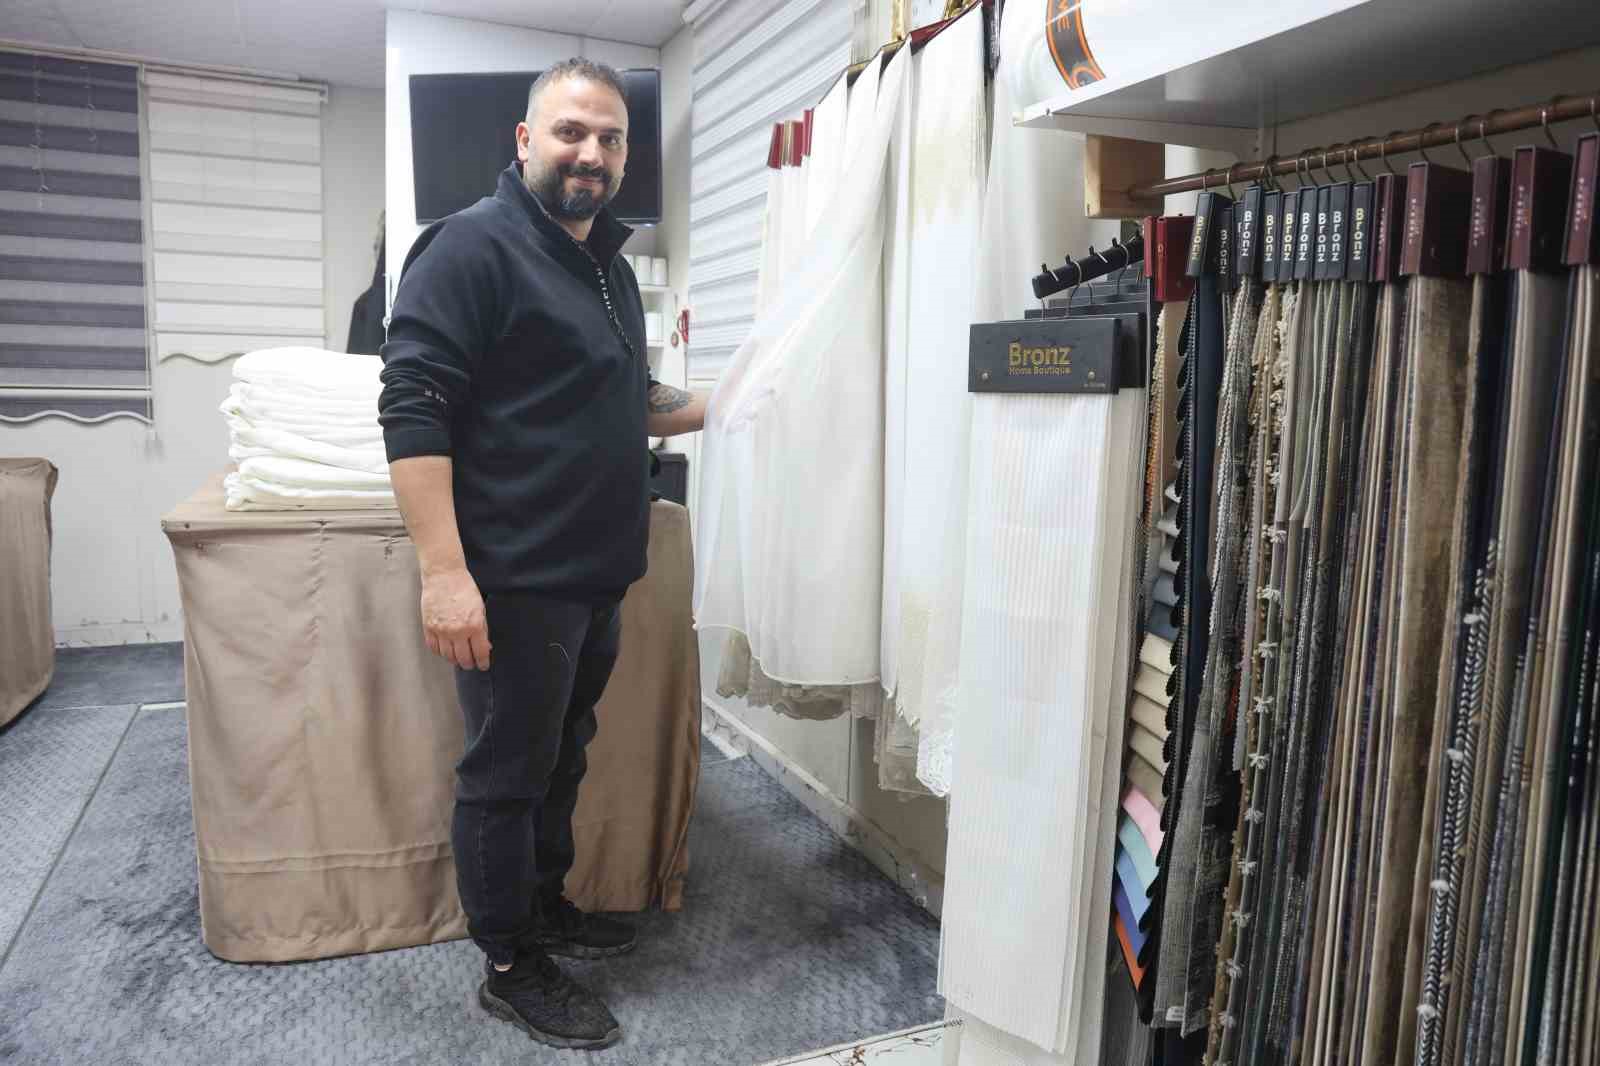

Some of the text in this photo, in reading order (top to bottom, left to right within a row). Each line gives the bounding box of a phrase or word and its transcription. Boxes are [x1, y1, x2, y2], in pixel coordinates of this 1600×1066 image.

[1191, 215, 1204, 260] Bronz
[1241, 210, 1253, 256] Bronz
[1265, 214, 1274, 262] Bronz
[1283, 212, 1293, 261] Bronz
[1299, 212, 1310, 261] Bronz
[1317, 212, 1327, 262] Bronz
[1332, 210, 1342, 261] Bronz
[1353, 207, 1364, 260] Bronz
[1008, 343, 1072, 367] Bronz
[1033, 366, 1072, 376] Boutique
